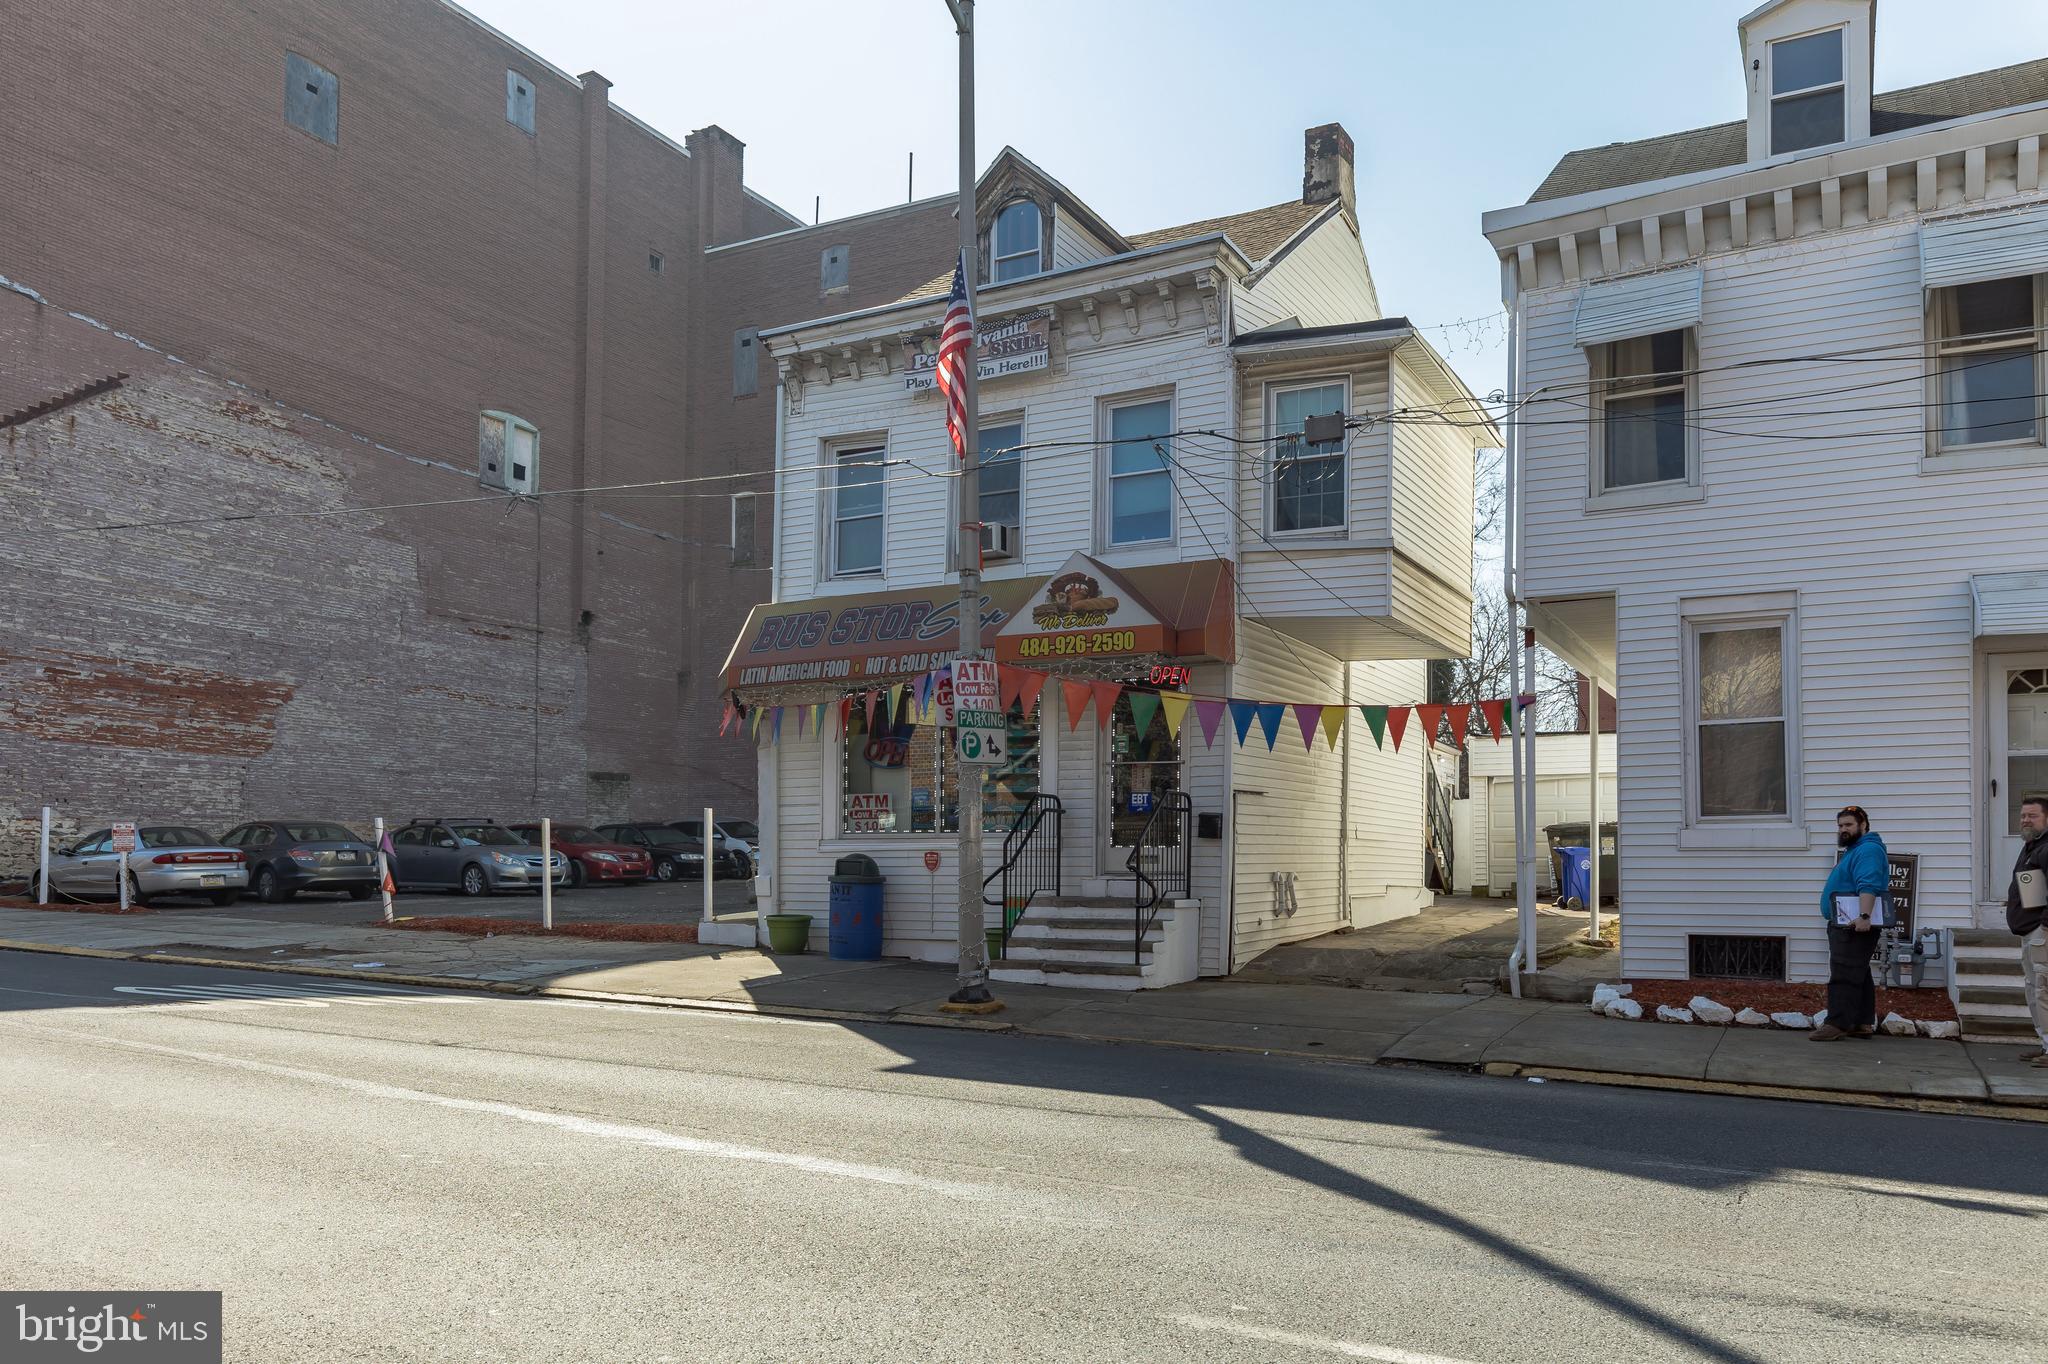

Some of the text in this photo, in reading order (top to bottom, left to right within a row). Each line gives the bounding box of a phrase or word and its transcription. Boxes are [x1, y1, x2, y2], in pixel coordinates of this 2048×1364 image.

[914, 321, 1028, 369] Pelvania
[906, 377, 932, 389] Play
[751, 611, 831, 653] BUS
[829, 601, 933, 645] STOP
[1039, 613, 1108, 631] We Deliver
[1019, 631, 1136, 657] 484-926-2590
[740, 666, 768, 685] LATIN
[768, 662, 822, 683] AMERICAN
[822, 660, 851, 678] FOOD
[865, 656, 889, 675] HOT
[888, 657, 898, 673] &
[899, 653, 929, 673] COLD
[957, 663, 995, 680] ATM
[1150, 666, 1191, 685] OPEN
[960, 684, 977, 694] Low
[960, 711, 1004, 727] PARKING
[852, 794, 889, 808] ATM
[1131, 793, 1149, 804] EBT
